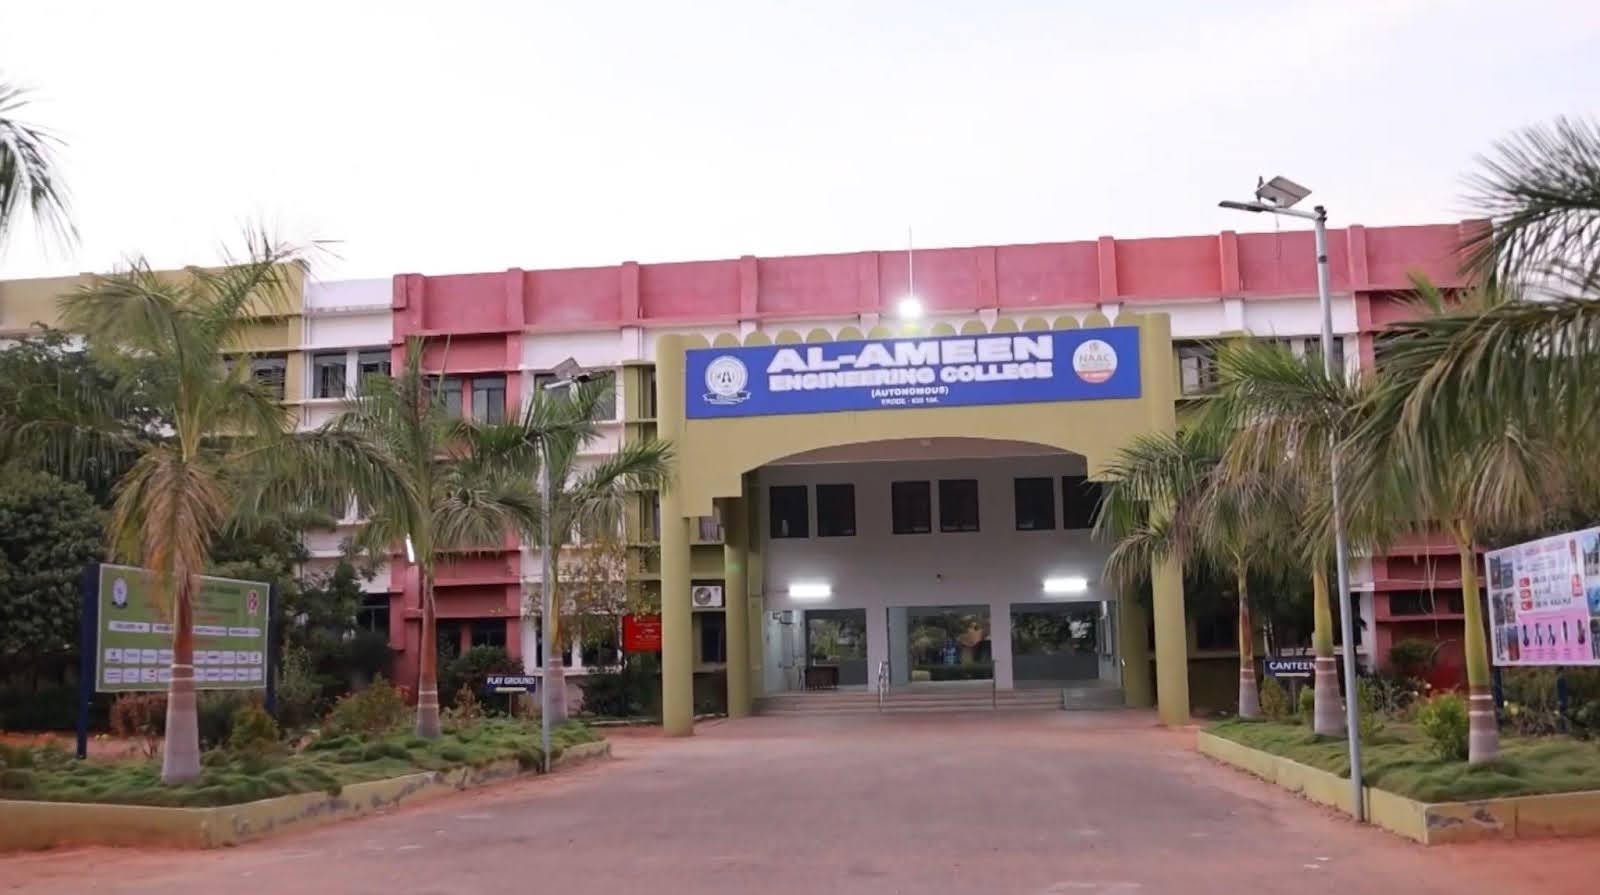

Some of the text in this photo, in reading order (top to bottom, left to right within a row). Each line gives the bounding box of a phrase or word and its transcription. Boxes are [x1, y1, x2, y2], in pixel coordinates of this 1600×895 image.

[767, 336, 1053, 373] AL-AMEEN
[769, 362, 1053, 392] ENGINEERING COLLEGE
[871, 386, 949, 399] (AUTONOMOUS)
[1269, 661, 1315, 670] CANTEEN
[487, 676, 535, 685] PLAY GROUND
